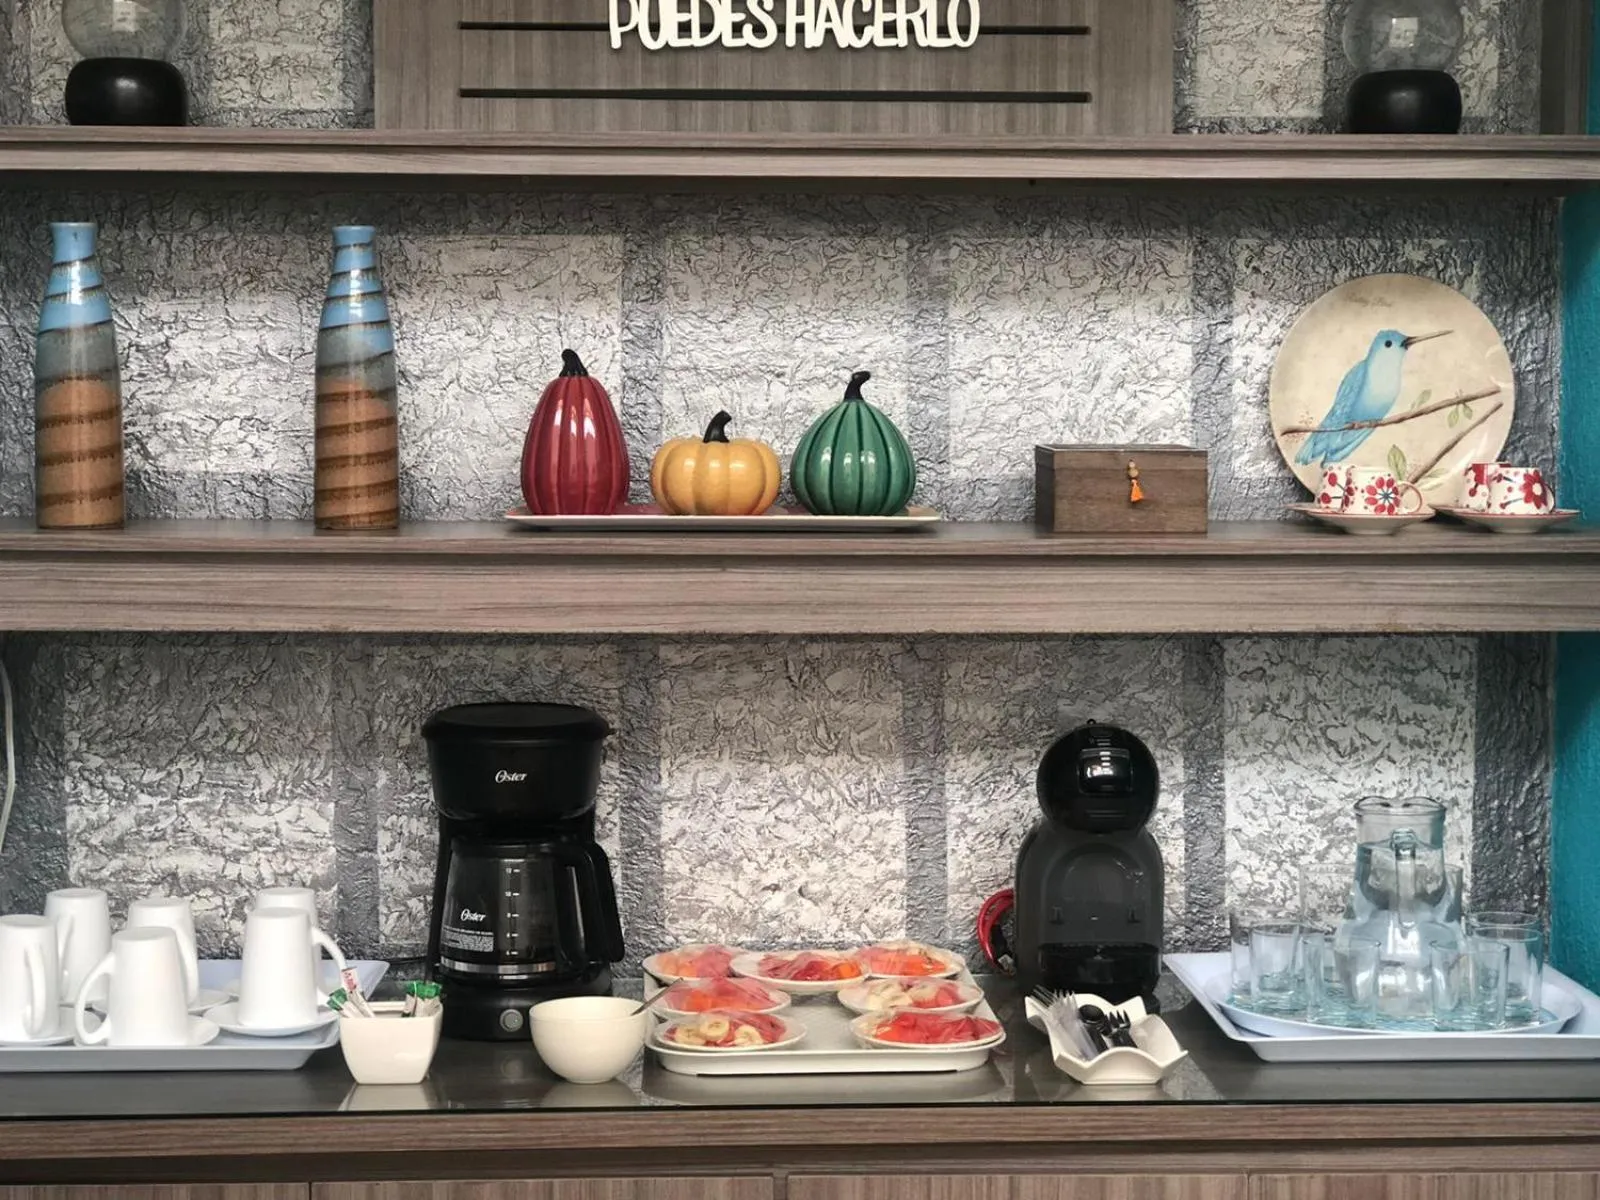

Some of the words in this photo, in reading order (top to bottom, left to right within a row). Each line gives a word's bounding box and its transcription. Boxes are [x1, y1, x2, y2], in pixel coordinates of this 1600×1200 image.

[609, 0, 777, 49] PUEDES
[785, 0, 980, 48] HACERLO
[495, 769, 527, 783] Oster
[460, 908, 486, 921] Oster
